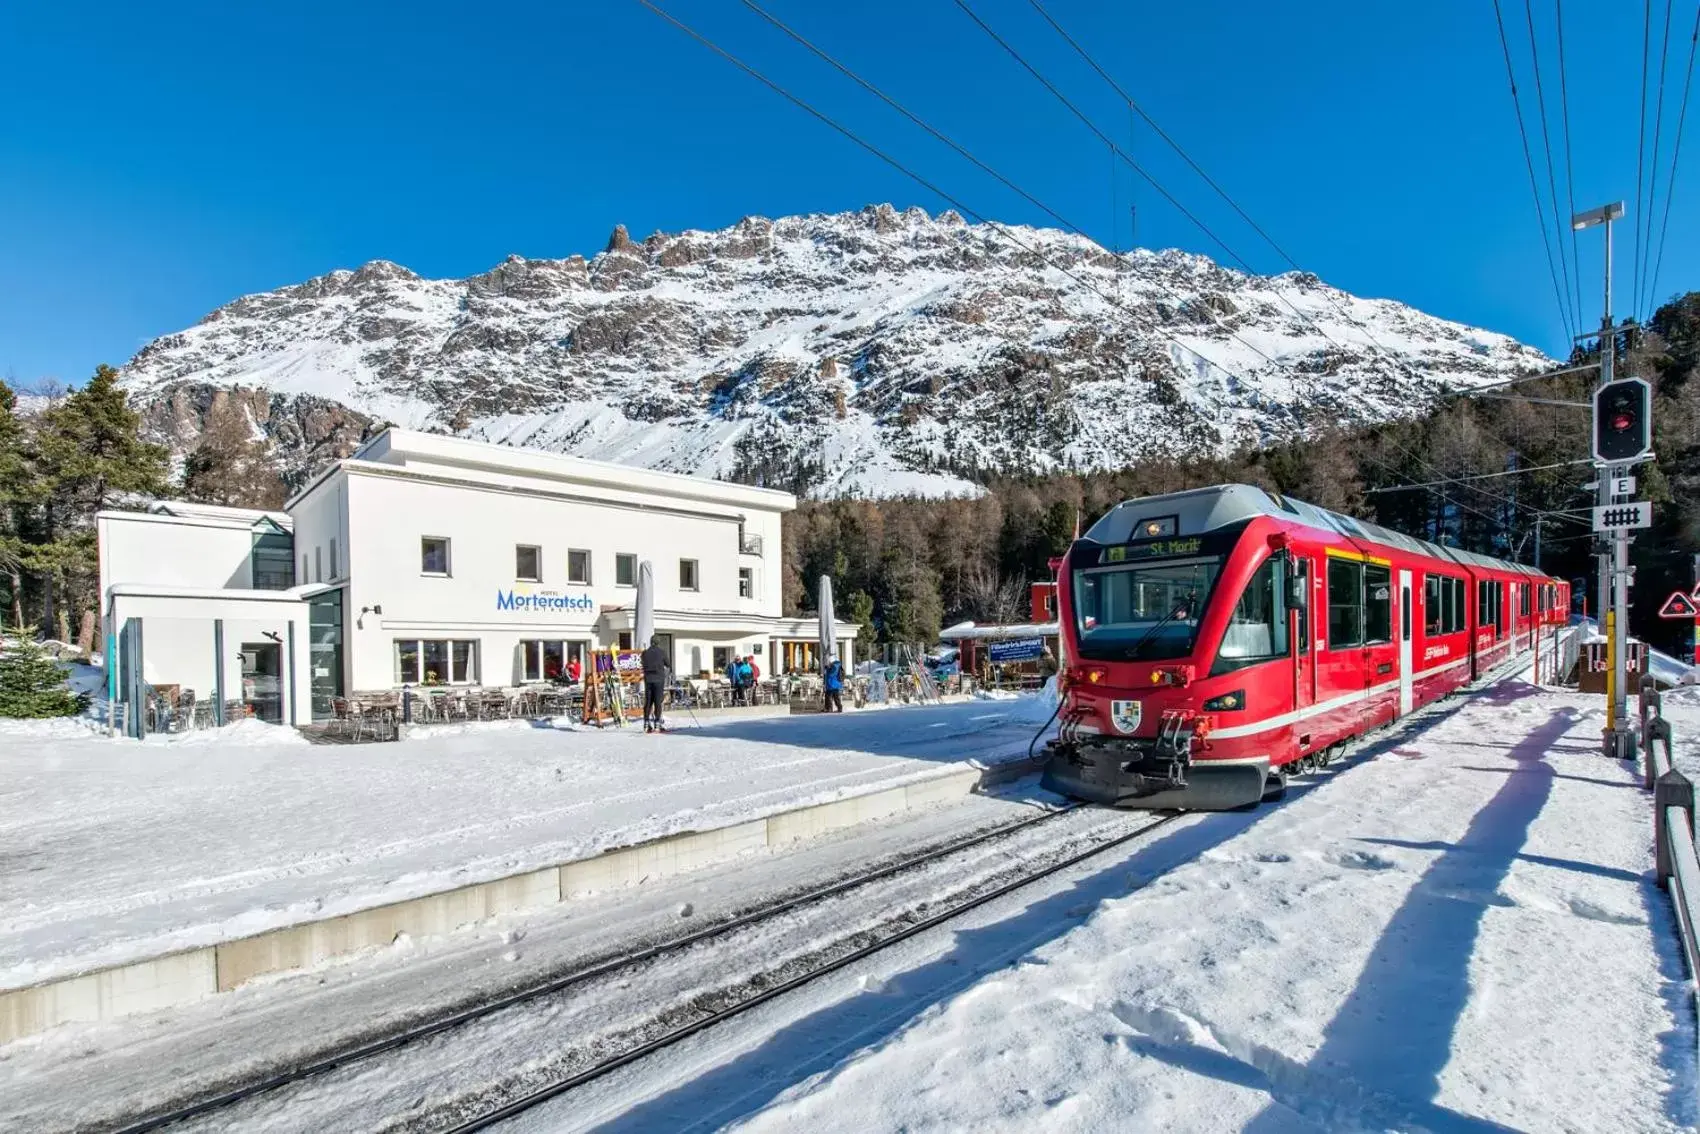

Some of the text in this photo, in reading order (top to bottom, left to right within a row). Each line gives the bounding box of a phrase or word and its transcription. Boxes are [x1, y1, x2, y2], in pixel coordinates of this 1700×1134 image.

[1618, 479, 1628, 492] E
[1150, 538, 1201, 554] St Morit
[497, 589, 593, 610] Morteratsch
